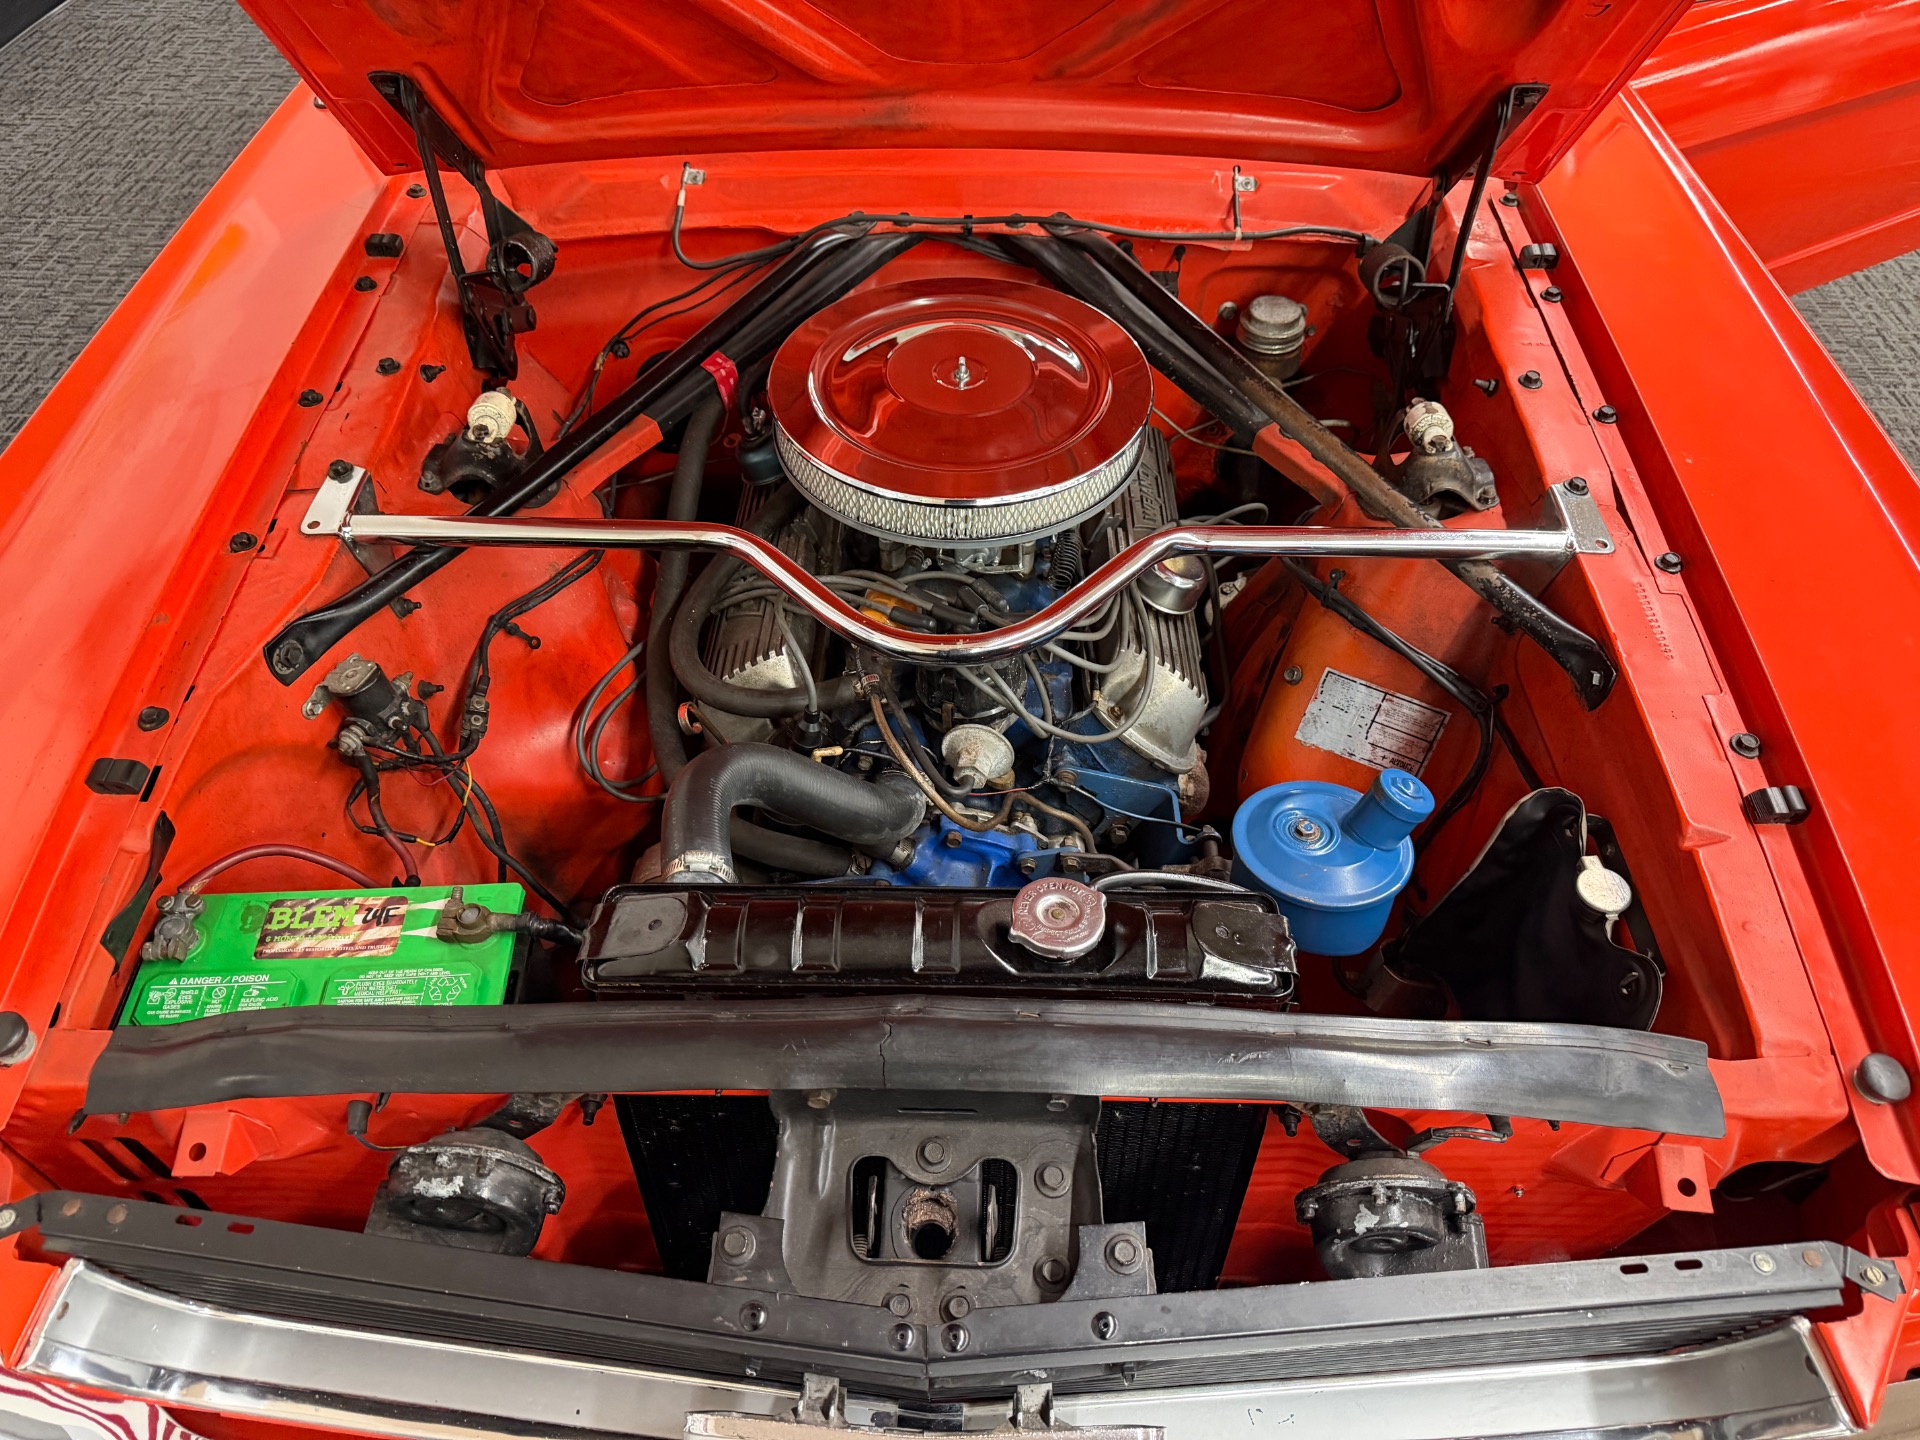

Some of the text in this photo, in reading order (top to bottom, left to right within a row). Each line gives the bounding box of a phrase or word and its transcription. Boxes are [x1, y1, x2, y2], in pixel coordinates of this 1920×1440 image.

[1019, 882, 1085, 916] NEVER OPEN HOT
[267, 905, 360, 930] BLEM
[180, 976, 221, 984] DANGER
[232, 974, 270, 982] POISON
